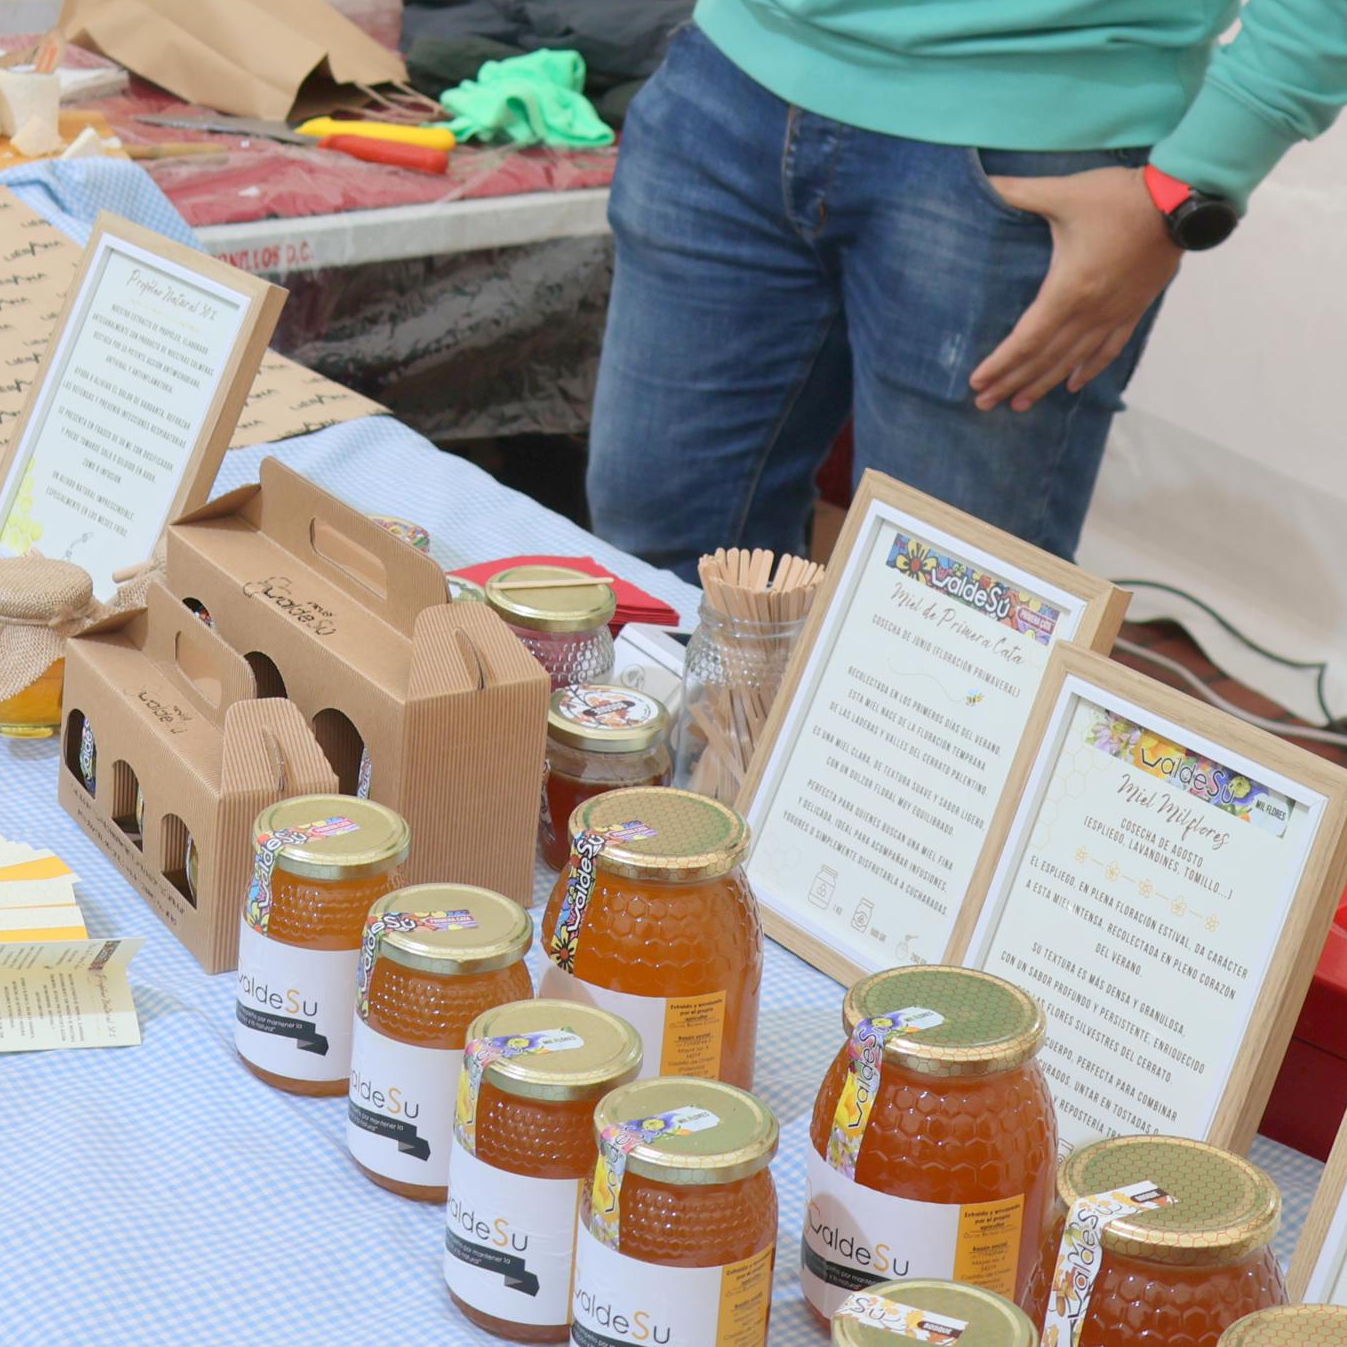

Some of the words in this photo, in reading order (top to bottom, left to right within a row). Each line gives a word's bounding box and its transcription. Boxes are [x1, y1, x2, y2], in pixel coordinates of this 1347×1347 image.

[890, 581, 921, 612] Miel
[922, 602, 938, 622] de
[938, 607, 992, 650] Primera
[992, 636, 1025, 665] Cata
[1117, 773, 1155, 809] Miel
[1157, 792, 1231, 851] Milflores
[1265, 803, 1287, 822] FLORES
[1120, 817, 1156, 844] COSECHA
[1157, 836, 1170, 851] DE
[1170, 843, 1203, 868] AGOSTO
[1183, 866, 1232, 899] TOMILLO...)
[1025, 879, 1031, 888] A
[1032, 882, 1051, 899] ESTA
[1106, 922, 1159, 958] RECOLECTADA
[1160, 951, 1172, 965] EN
[1172, 958, 1198, 979] PLENO
[1198, 972, 1236, 1000] CORAZÓN
[1029, 855, 1038, 867] EL
[1078, 881, 1089, 894] EN
[1090, 887, 1114, 907] PLENA
[1115, 900, 1156, 930] FLORACIÓN
[1193, 942, 1205, 956] DA
[1206, 949, 1247, 979] CARÁCTER
[1031, 941, 1042, 955] SU
[1043, 948, 1076, 973] TEXTURA
[1076, 967, 1087, 980] ES
[1088, 973, 1105, 990] MÁS
[1105, 983, 1130, 1004] DENSA
[1132, 998, 1138, 1008] Y
[1094, 942, 1108, 958] DEL
[1000, 950, 1016, 966] CON
[1016, 959, 1027, 972] UN
[1027, 966, 1052, 986] SABOR
[1052, 980, 1091, 1009] PROFUNDO
[1092, 1003, 1098, 1012] Y
[1153, 1037, 1204, 1074] ENRIQUECIDO
[1046, 1002, 1074, 1026] FLORES
[1074, 1019, 1119, 1052] SILVESTRES
[1119, 1045, 1134, 1062] DEL
[1053, 1094, 1058, 1107] Y
[1058, 1099, 1104, 1134] REPOSTERÍA
[1073, 1081, 1099, 1102] UNTAR
[1099, 1096, 1111, 1110] EN
[1112, 1103, 1151, 1136] TOSTADAS
[1076, 1055, 1113, 1084] PERFECTA
[1115, 1078, 1135, 1097] PARA
[1136, 1091, 1177, 1121] COMBINAR
[921, 1321, 952, 1336] BOSQUE
